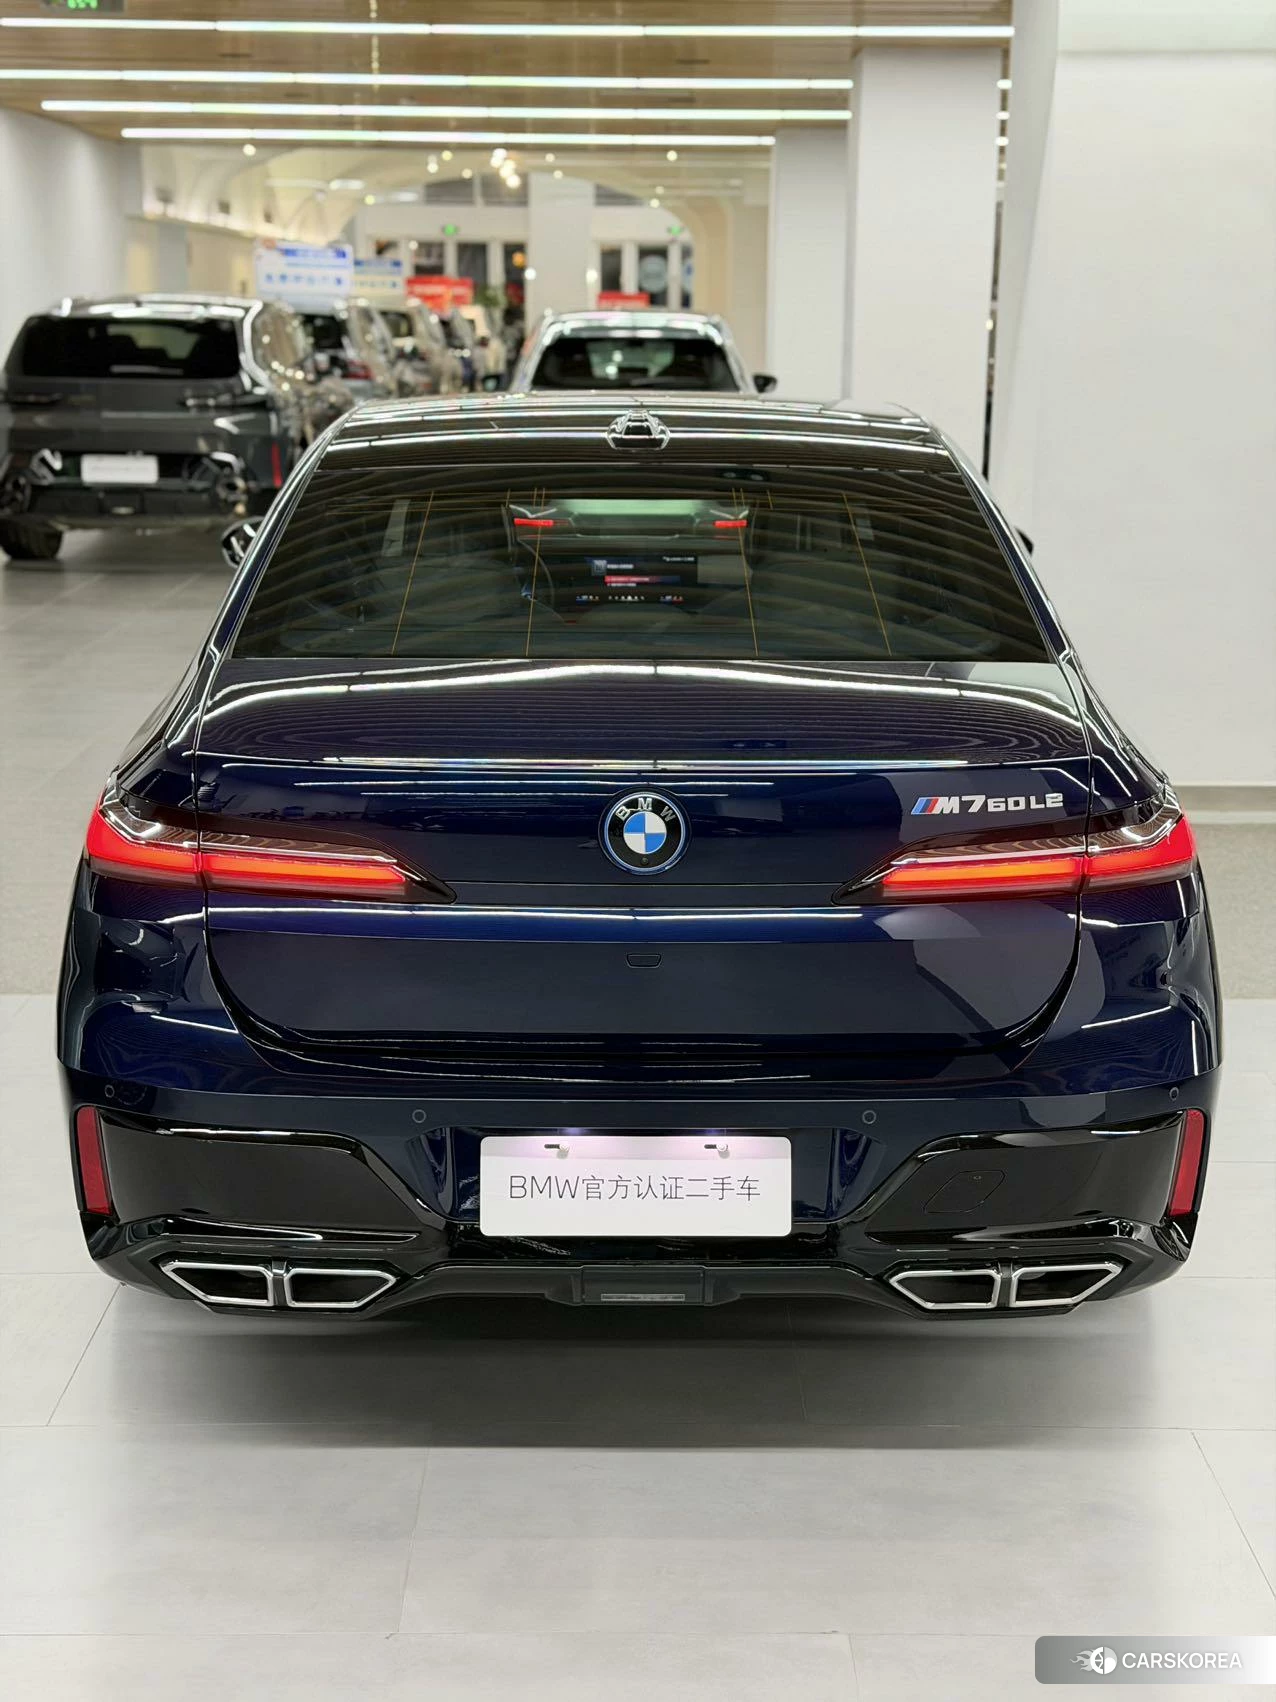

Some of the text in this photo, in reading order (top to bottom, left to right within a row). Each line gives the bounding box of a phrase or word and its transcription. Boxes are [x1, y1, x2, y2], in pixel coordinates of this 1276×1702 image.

[615, 797, 677, 822] BMW
[508, 1174, 761, 1201] BMW官方认证二手车
